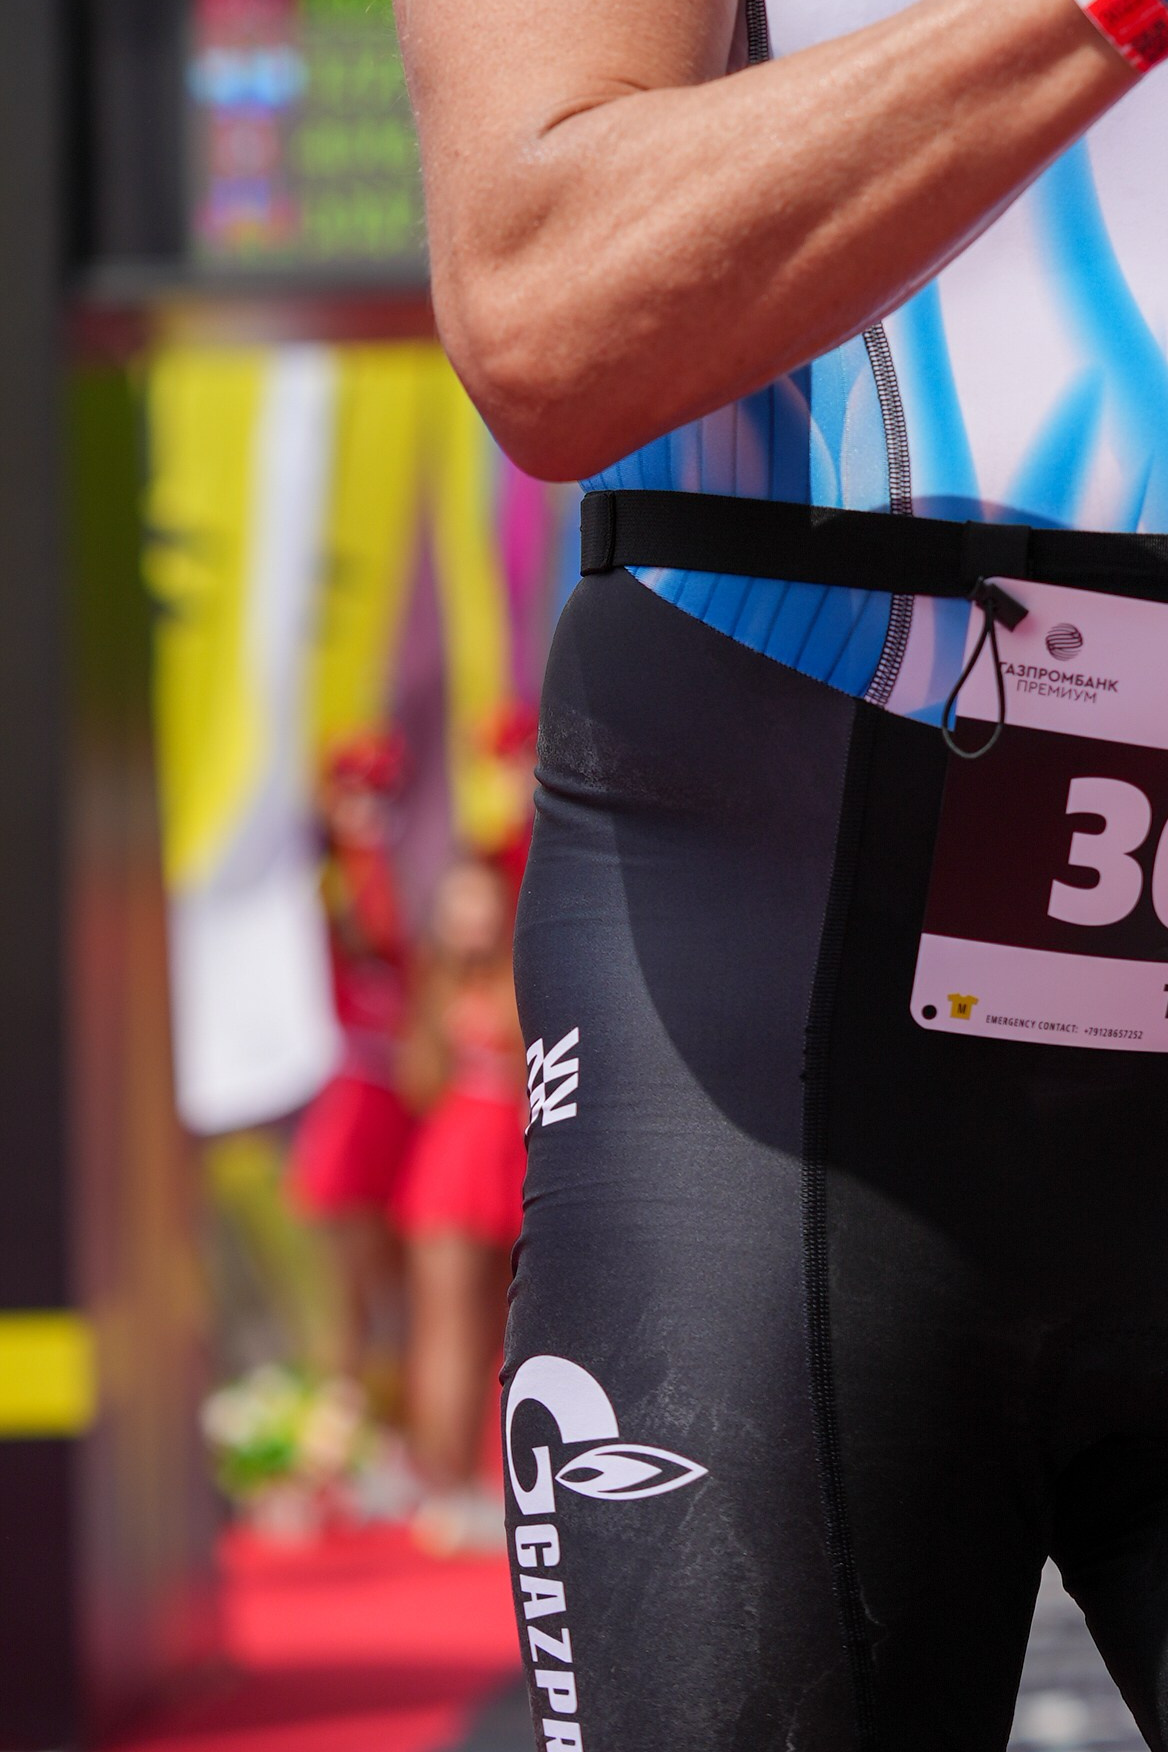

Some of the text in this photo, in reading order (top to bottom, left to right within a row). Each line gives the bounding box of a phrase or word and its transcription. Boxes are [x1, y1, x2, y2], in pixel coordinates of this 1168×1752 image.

[1016, 679, 1098, 704] ПРЕМИУМ
[957, 1003, 967, 1014] M
[986, 1014, 1144, 1040] EMERGENCY CONTACT: +79128657252
[515, 1523, 584, 1752] GAZPR
